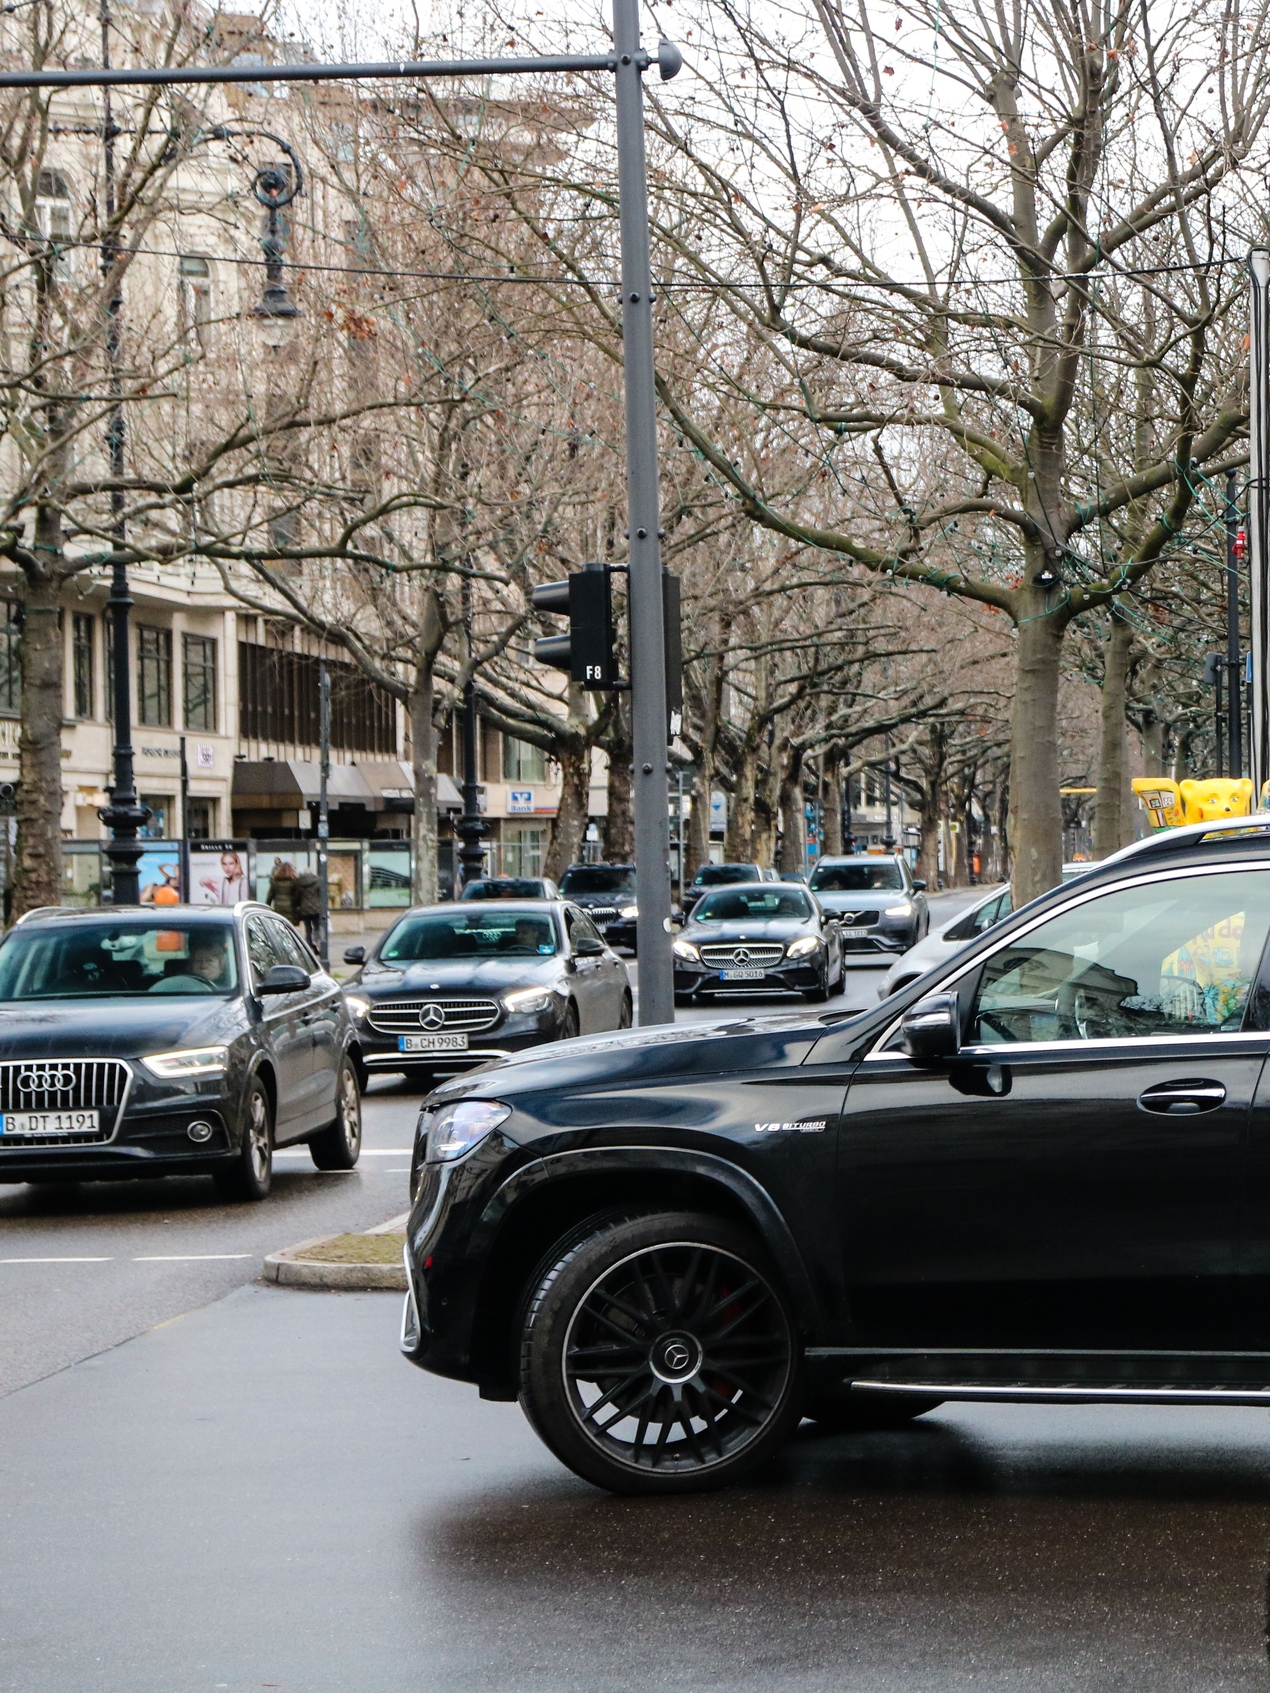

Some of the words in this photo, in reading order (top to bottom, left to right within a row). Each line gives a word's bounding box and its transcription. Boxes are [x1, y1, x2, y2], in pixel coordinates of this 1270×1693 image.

[586, 665, 602, 680] F8
[420, 1038, 435, 1048] CH
[437, 1036, 466, 1048] 9983
[5, 1116, 16, 1132] B
[28, 1115, 49, 1131] DT
[54, 1113, 96, 1130] 1191
[754, 1123, 781, 1132] V8
